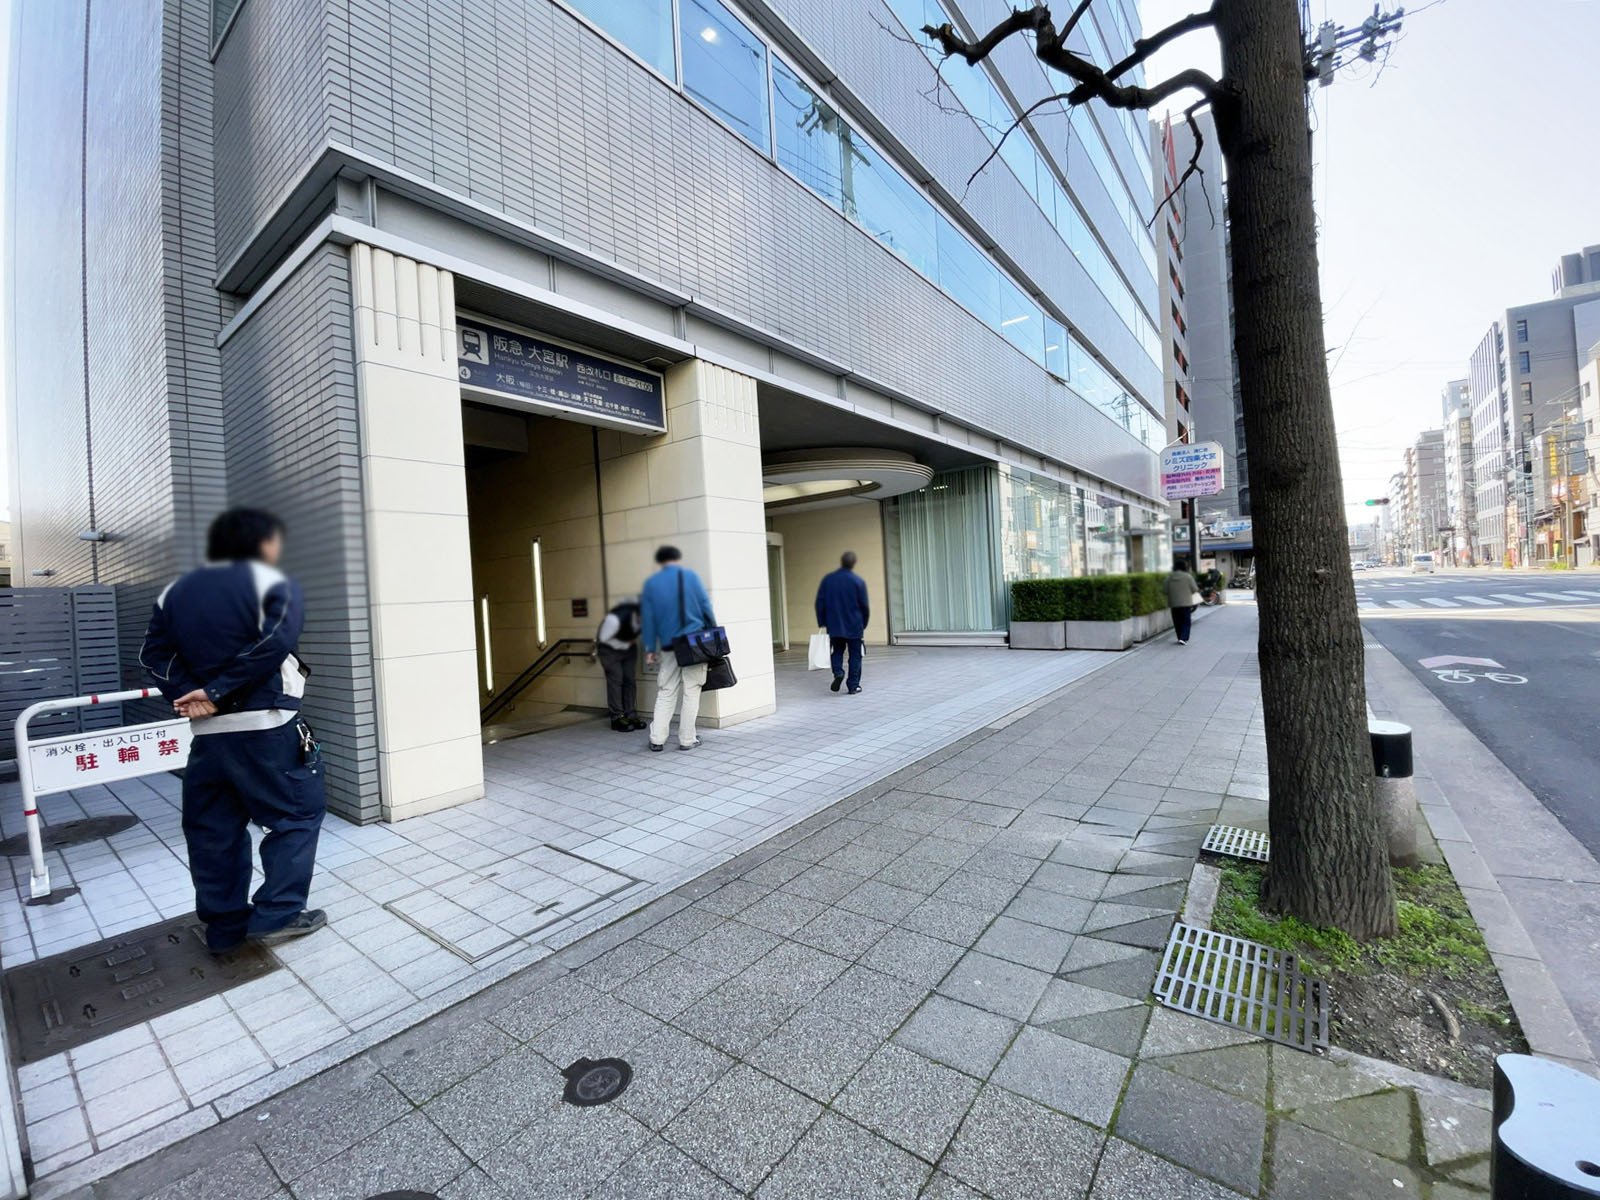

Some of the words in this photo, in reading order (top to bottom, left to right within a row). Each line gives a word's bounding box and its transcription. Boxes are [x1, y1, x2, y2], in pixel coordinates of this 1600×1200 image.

[493, 335, 523, 356] 阪急
[528, 345, 570, 369] 大宮駅
[576, 363, 611, 381] 西改札口
[1173, 462, 1207, 472] クリニック
[45, 729, 167, 758] 消火栓・出入口に付
